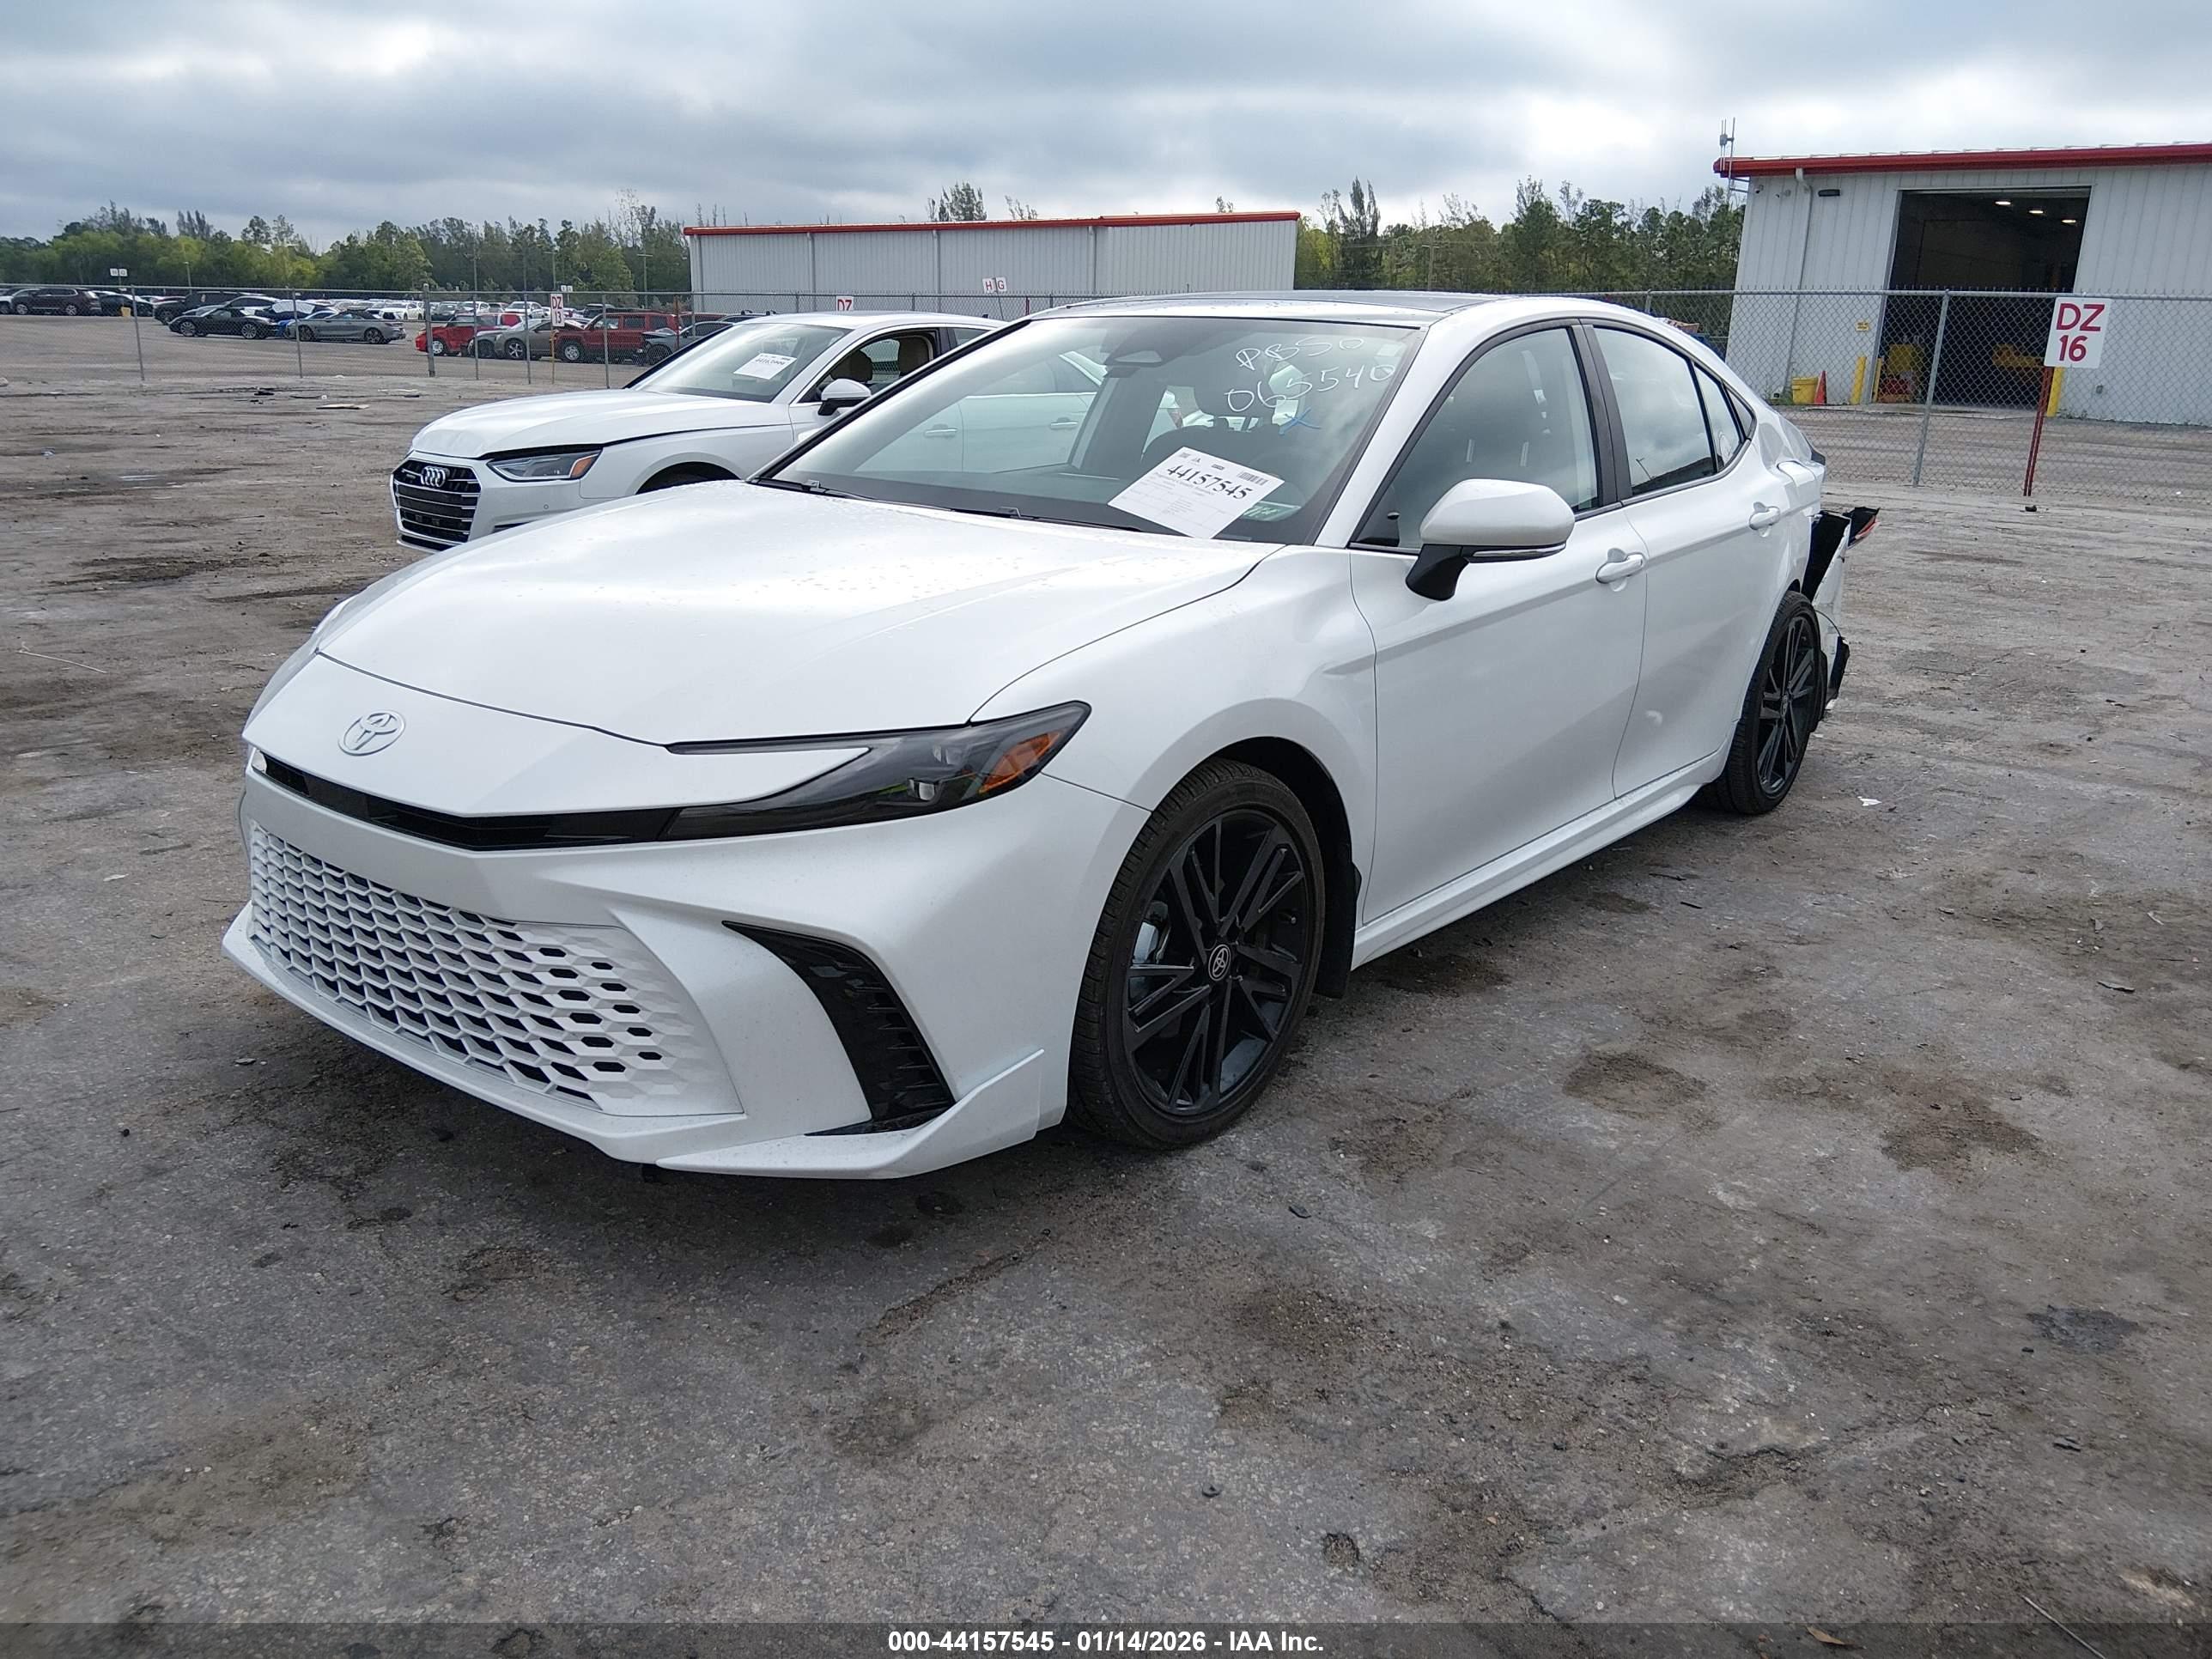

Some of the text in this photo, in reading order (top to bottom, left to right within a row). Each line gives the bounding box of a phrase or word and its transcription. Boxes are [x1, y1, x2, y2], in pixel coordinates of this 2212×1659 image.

[985, 279, 1005, 290] H G
[551, 295, 562, 310] DZ
[554, 311, 562, 324] 13
[2056, 303, 2106, 331] DZ
[2059, 334, 2088, 362] 16
[1224, 364, 1395, 412] 065540
[1166, 464, 1254, 500] 44157545
